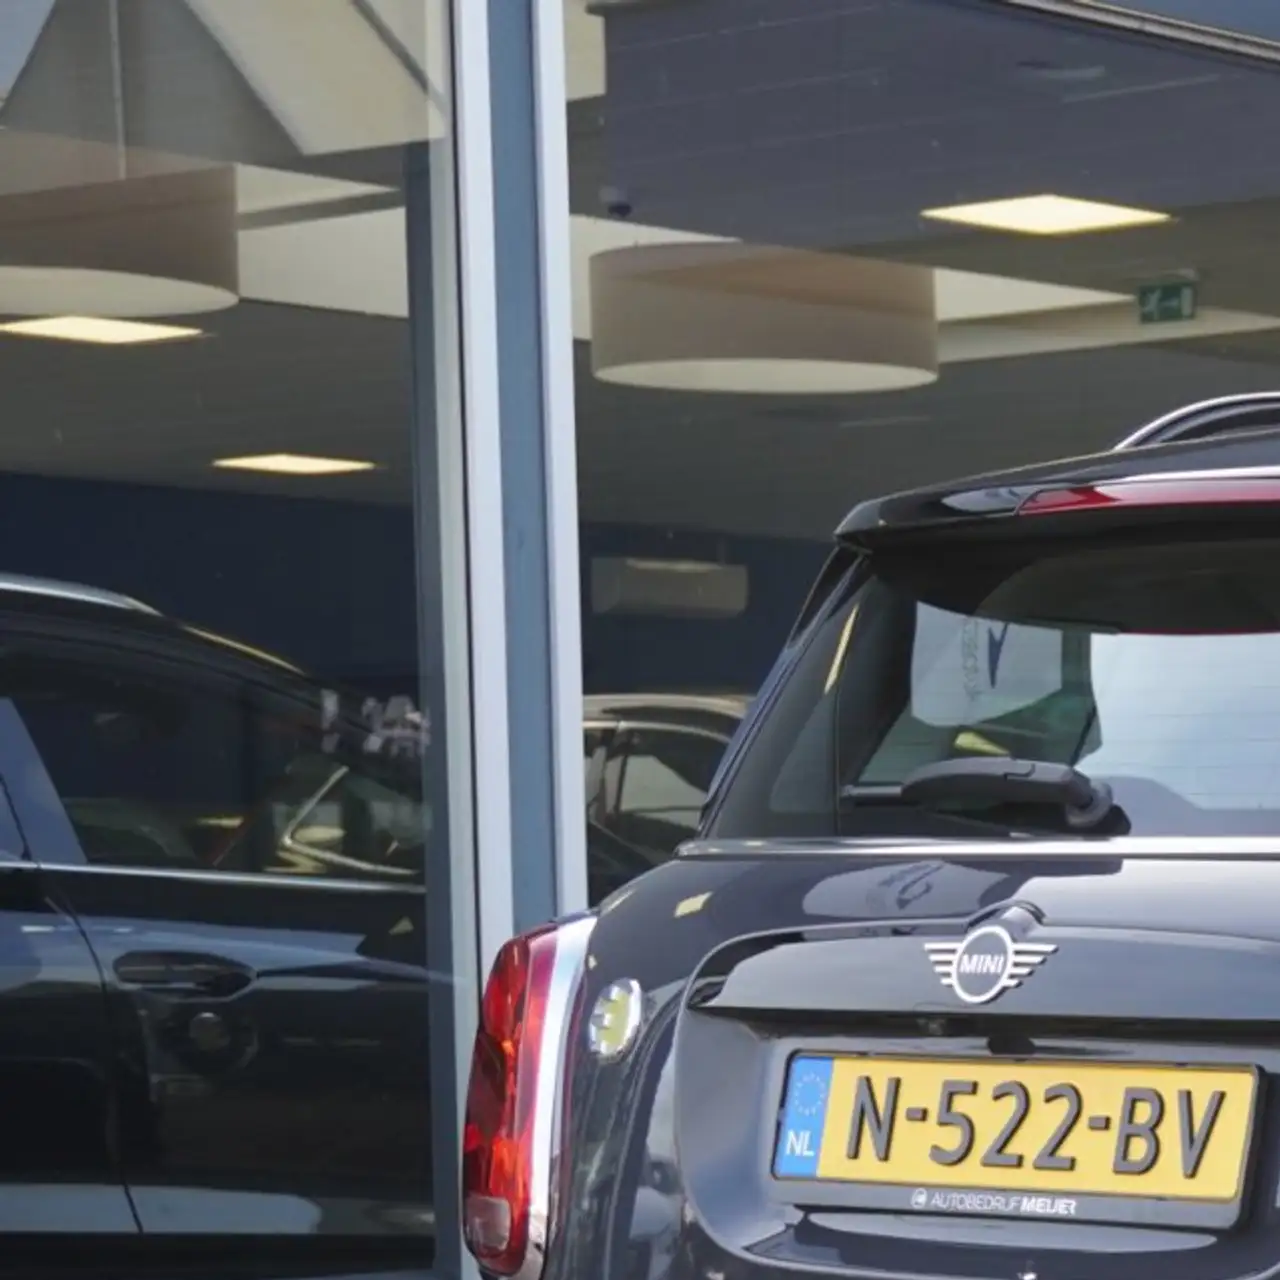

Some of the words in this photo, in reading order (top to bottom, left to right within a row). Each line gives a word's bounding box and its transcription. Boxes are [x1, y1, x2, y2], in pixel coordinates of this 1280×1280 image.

[958, 953, 1005, 975] MINI
[846, 1074, 1227, 1180] N-522-BV
[784, 1129, 816, 1158] NL
